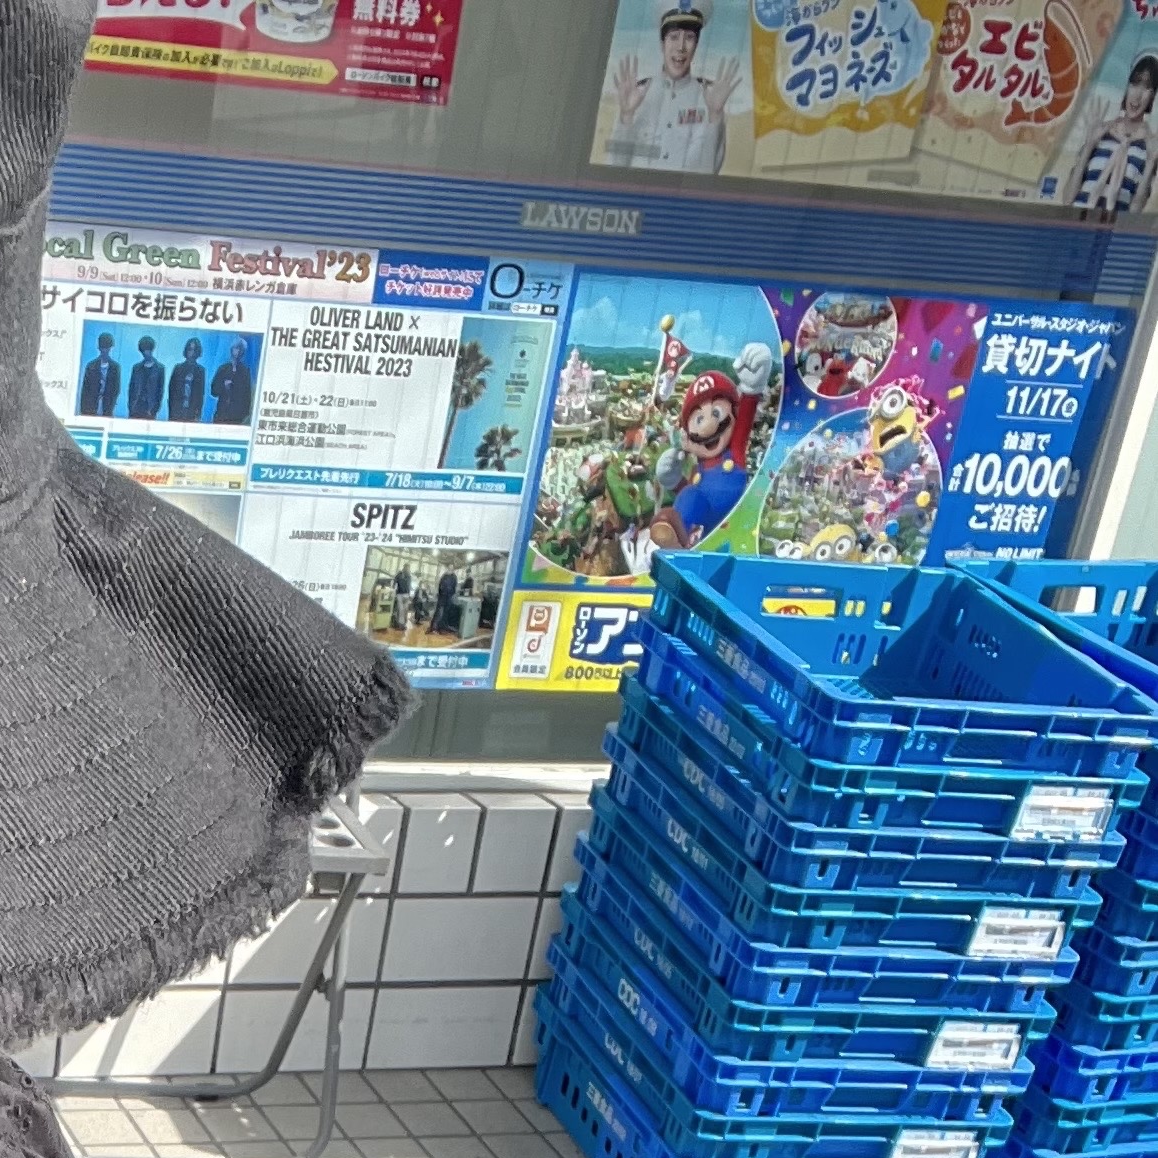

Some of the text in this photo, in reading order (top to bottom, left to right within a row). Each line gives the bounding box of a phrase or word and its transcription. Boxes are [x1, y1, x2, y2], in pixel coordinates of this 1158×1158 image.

[979, 19, 1043, 61] エビ
[951, 49, 1045, 98] タルタル
[523, 202, 640, 234] LAWSON
[102, 231, 202, 270] Green
[77, 265, 99, 278] 9/9
[42, 284, 244, 324] サイコロを振らない
[310, 306, 360, 329] OLIVER
[365, 310, 404, 331] LAND
[271, 327, 457, 358] THE GREAT SATSUMANIAN
[982, 333, 1117, 380] 貸切ナイト
[304, 352, 413, 377] HESTIVAL 2023
[156, 445, 183, 460] 7/26
[1003, 431, 1051, 452] 抽選で
[963, 453, 1072, 498] 10,000
[351, 503, 418, 530] SPITZ
[338, 532, 360, 542] TOUR
[573, 607, 592, 654] ローソン
